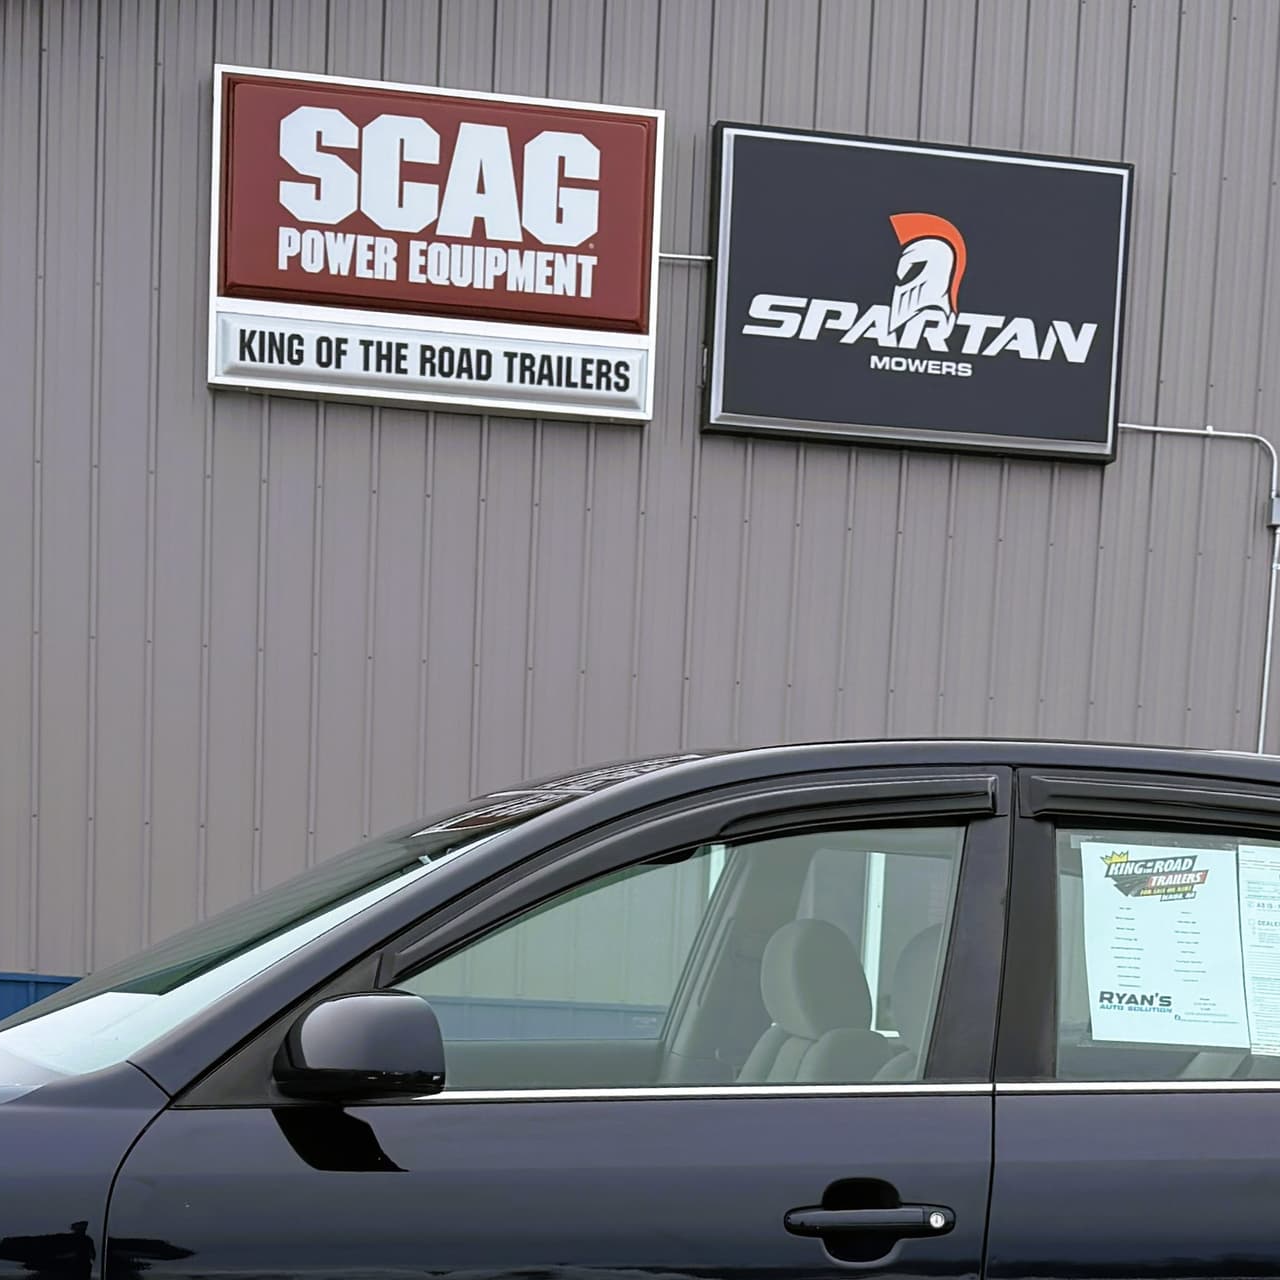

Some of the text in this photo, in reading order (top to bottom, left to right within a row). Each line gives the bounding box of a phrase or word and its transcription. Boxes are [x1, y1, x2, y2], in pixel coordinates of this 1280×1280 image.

[279, 105, 601, 247] SCAG
[278, 227, 597, 298] POWER EQUIPMENT
[743, 294, 1097, 363] SPARTAN
[239, 329, 630, 392] KING OF THE ROAD TRAILERS
[870, 355, 973, 377] MOWERS
[1109, 861, 1144, 875] KING
[1152, 858, 1193, 872] ROAD
[1150, 872, 1202, 886] TRAILERS
[1099, 991, 1172, 1007] RYAN'S
